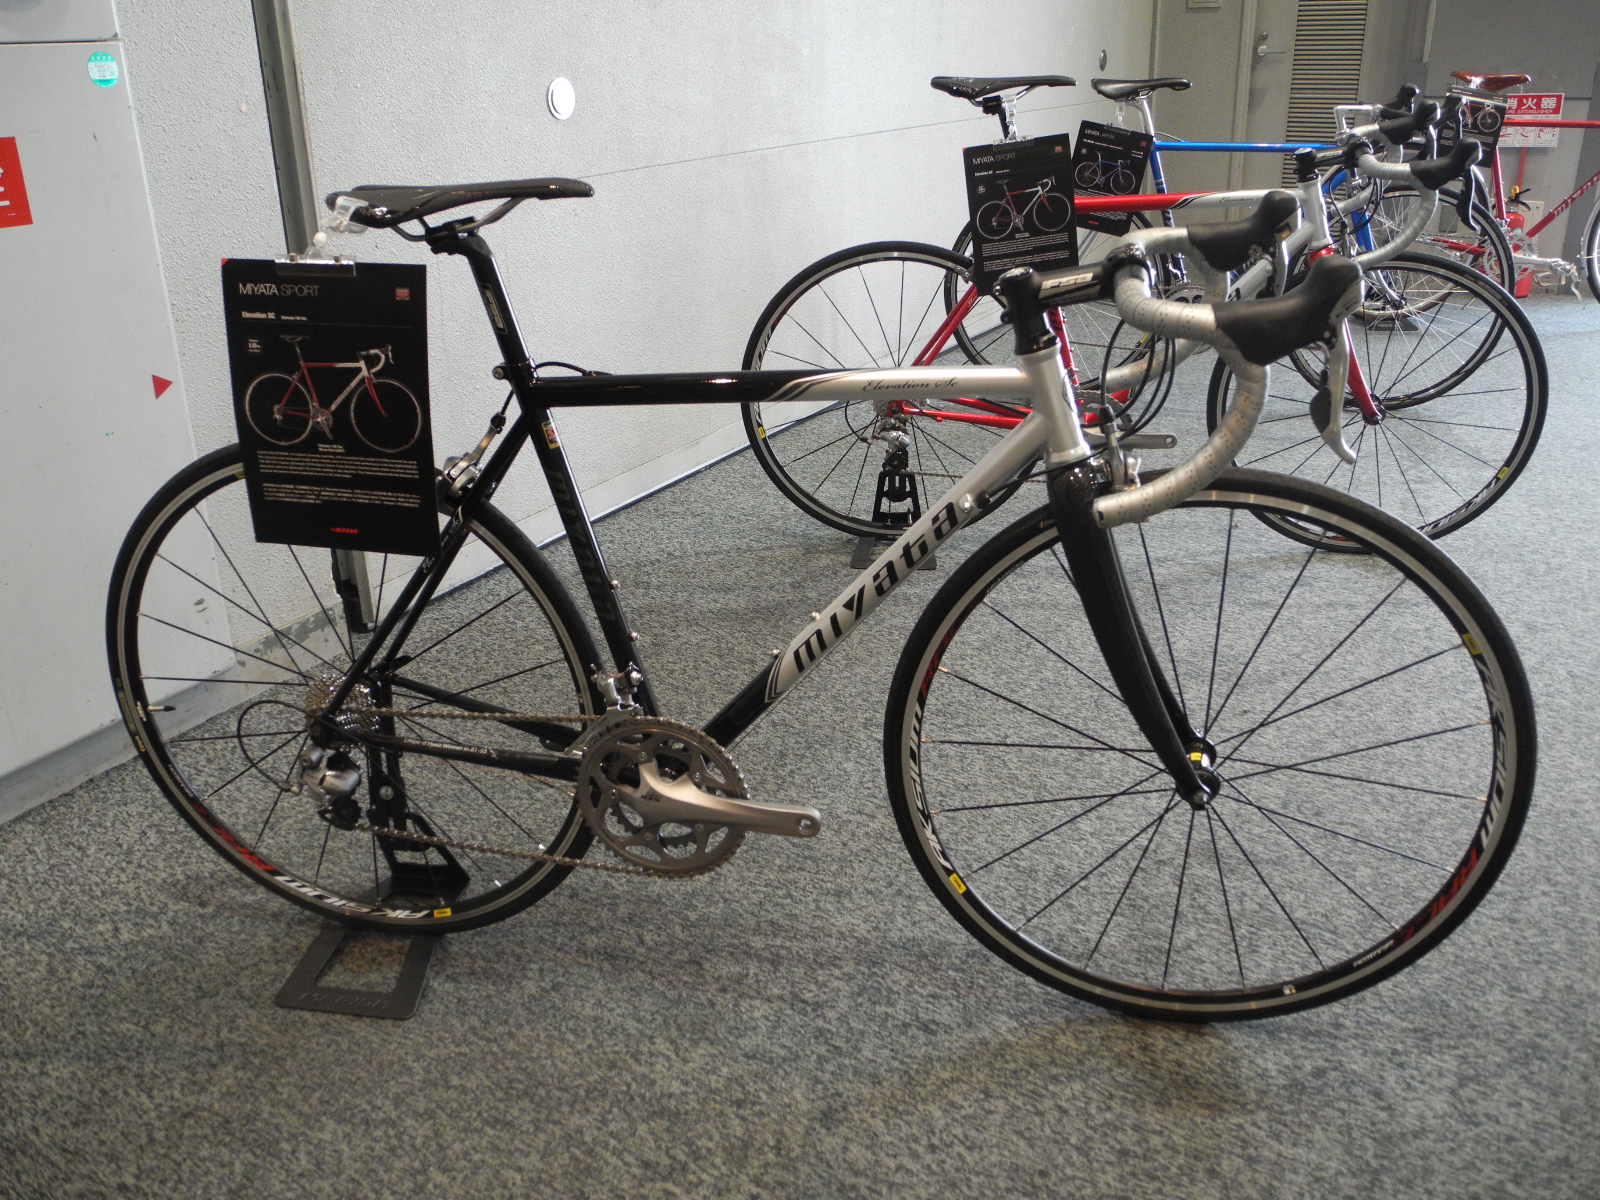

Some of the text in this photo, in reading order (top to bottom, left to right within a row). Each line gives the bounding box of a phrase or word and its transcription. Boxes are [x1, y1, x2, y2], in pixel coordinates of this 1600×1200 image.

[239, 283, 320, 296] MIYATA SPORT
[862, 380, 929, 393] Elevation
